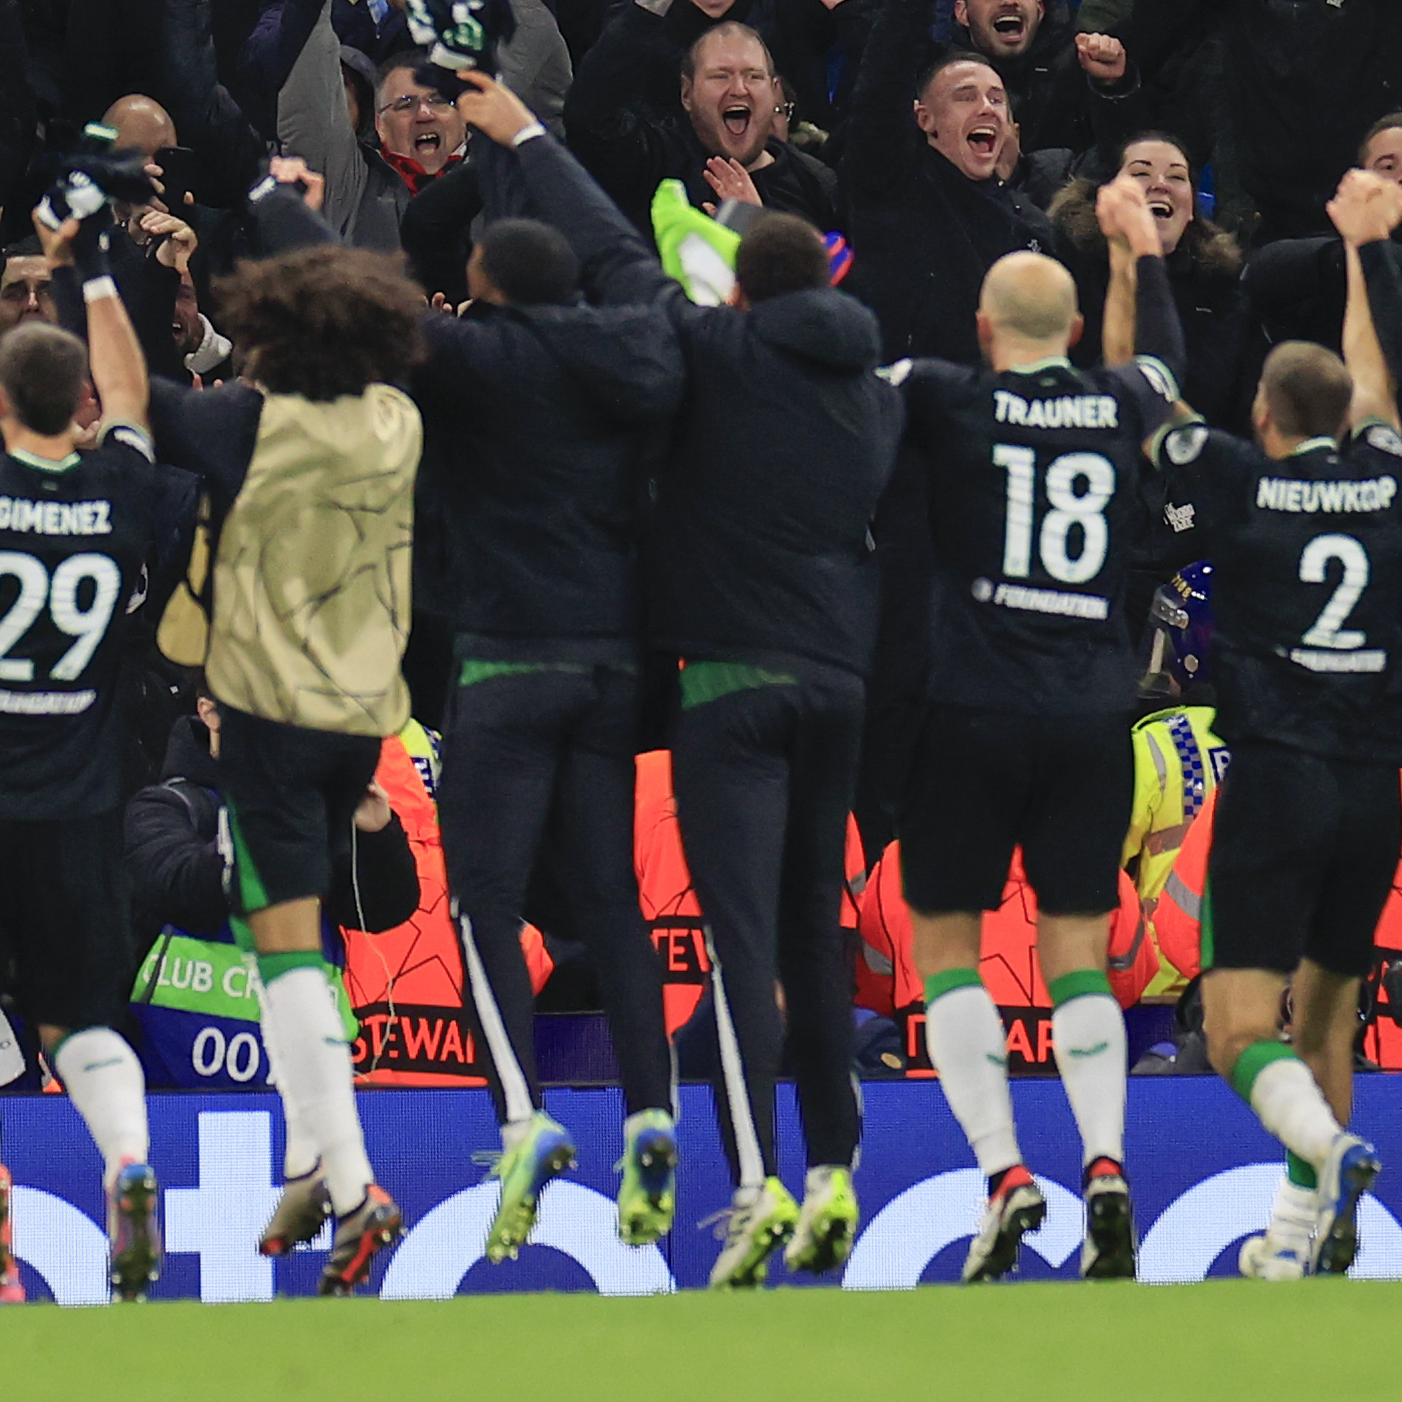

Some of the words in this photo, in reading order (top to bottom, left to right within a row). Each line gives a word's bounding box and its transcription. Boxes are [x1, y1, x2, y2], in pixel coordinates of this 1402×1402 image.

[992, 389, 1119, 429] TRAUNER
[991, 441, 1117, 584] 18
[1299, 532, 1371, 650] 2
[141, 953, 213, 993] CLUB
